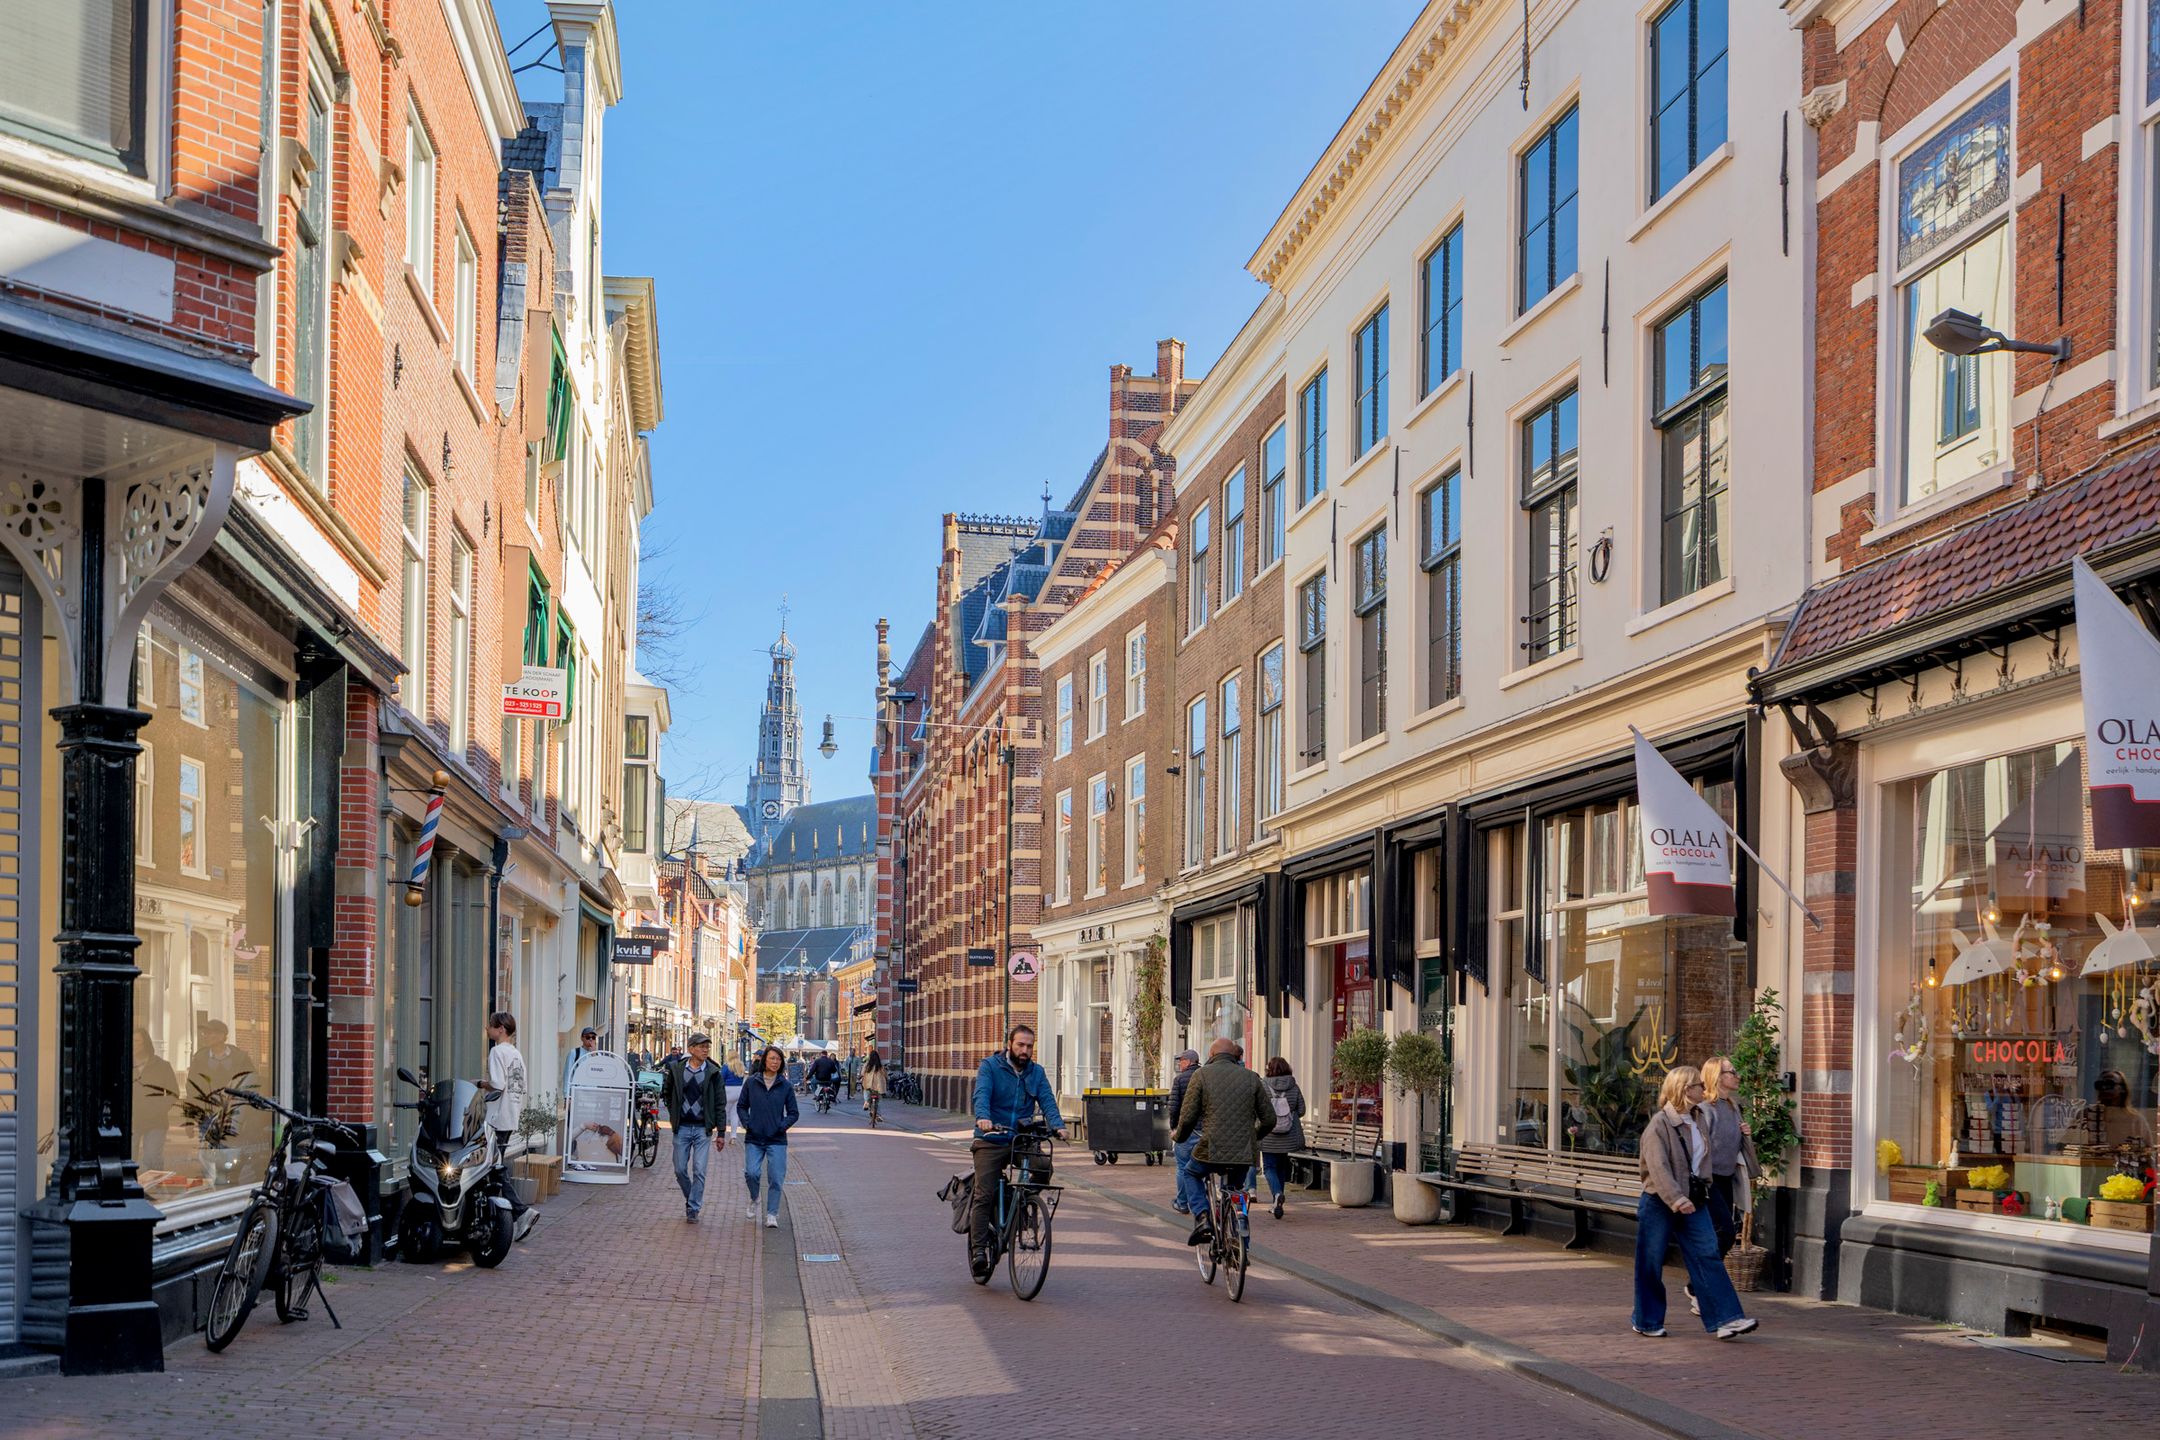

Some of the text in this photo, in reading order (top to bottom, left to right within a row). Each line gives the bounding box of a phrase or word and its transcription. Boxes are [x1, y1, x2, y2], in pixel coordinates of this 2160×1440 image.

[505, 686, 558, 698] TE KOOP
[2097, 718, 2160, 746] OLA
[2115, 747, 2160, 761] CHOC
[2105, 766, 2130, 776] eerlijk
[1650, 828, 1722, 849] OLALA
[1662, 847, 1716, 859] CHOCOLA
[616, 944, 640, 955] kvik
[1973, 1040, 2066, 1064] CHOCOLA
